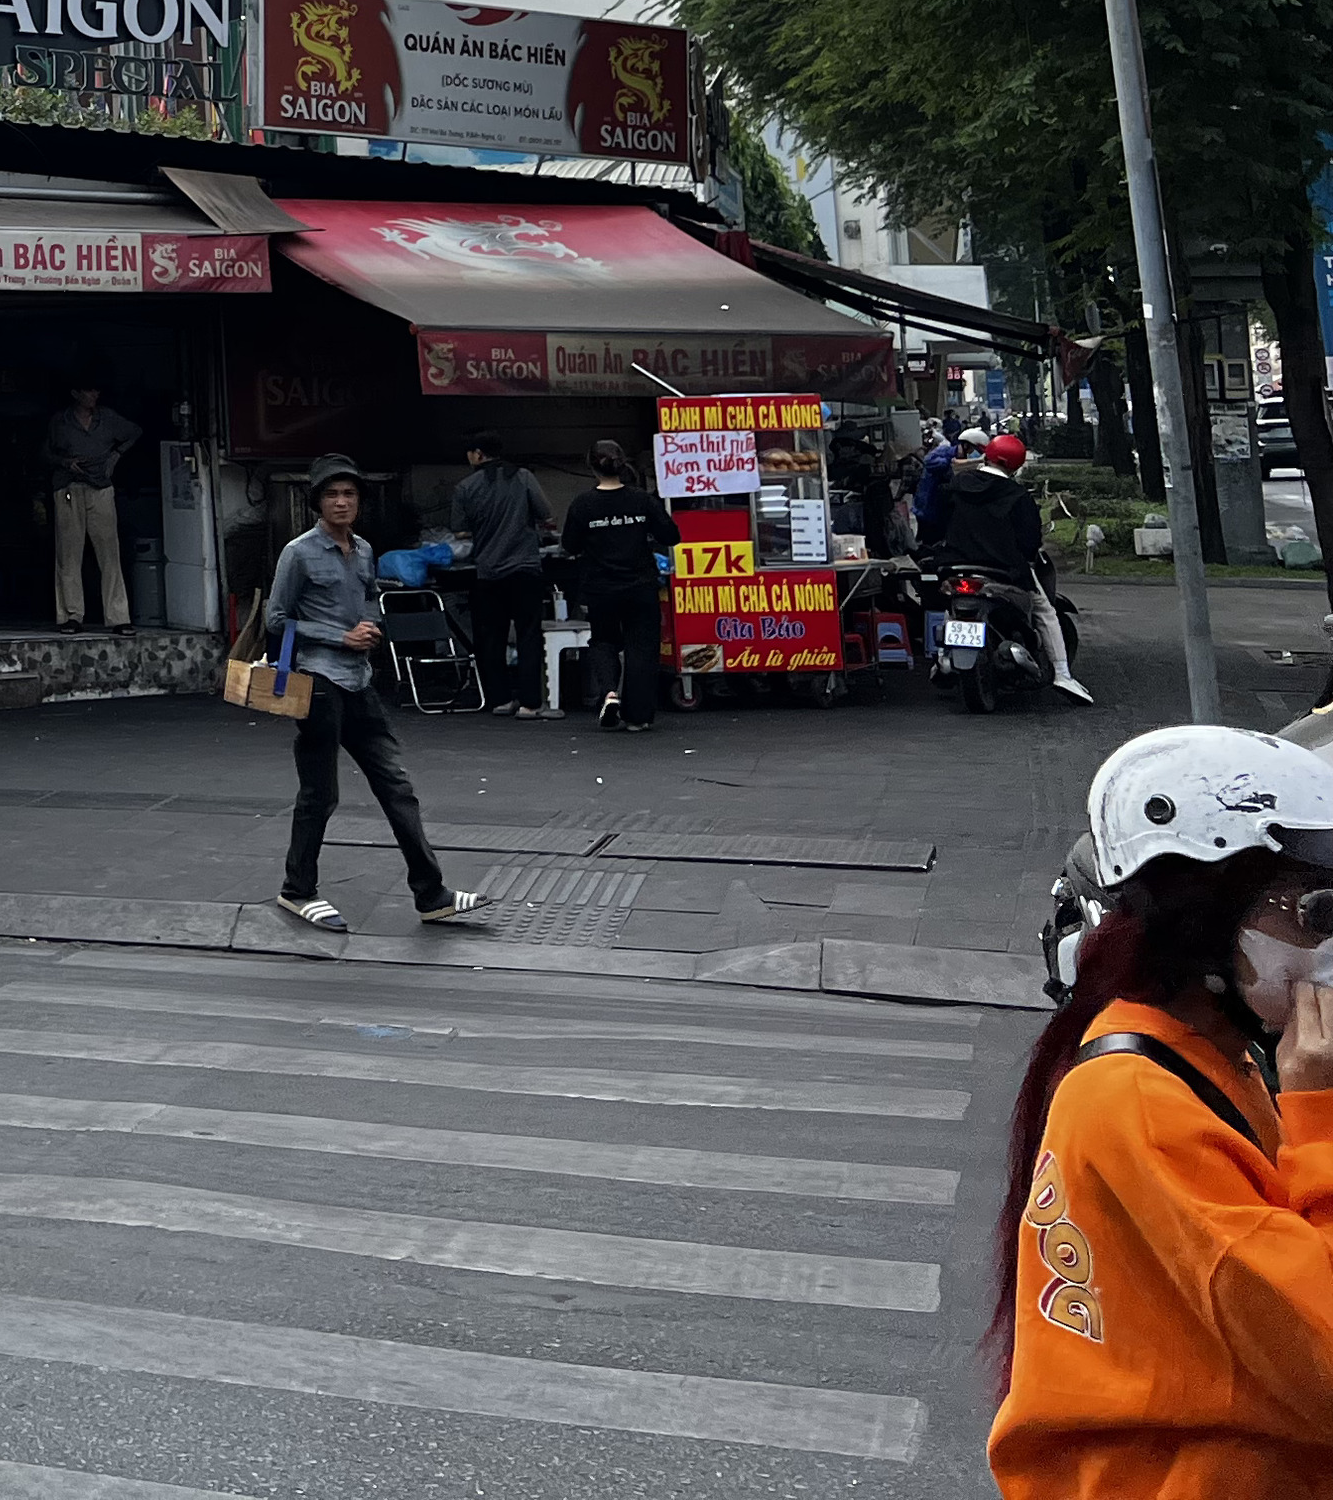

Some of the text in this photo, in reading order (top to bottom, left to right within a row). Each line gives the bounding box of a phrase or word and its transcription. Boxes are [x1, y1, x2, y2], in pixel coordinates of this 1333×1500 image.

[404, 32, 523, 62] QUÁN ĂN BÁC
[13, 44, 238, 102] SPECIAL
[310, 81, 337, 97] BIA
[280, 95, 367, 125] SAIGON
[627, 112, 650, 127] BIA
[600, 125, 676, 153] SAIGON
[14, 237, 65, 270] BÁC
[214, 249, 237, 259] BIA
[188, 260, 262, 277] SAIGON
[491, 348, 515, 360] BIA
[555, 345, 597, 375] Quán
[603, 342, 623, 374] Ăn
[633, 342, 689, 376] BÁC
[841, 352, 862, 363] BIA
[466, 361, 542, 380] SAIGON
[660, 398, 821, 430] BÁNH MÌ CHẢ CÁ NÓNG
[665, 460, 701, 480] Nem
[611, 515, 634, 525] de la
[682, 544, 747, 575] 17k
[674, 575, 834, 614] BÁNH MÌ CHẢ CÁ NÓNG
[726, 645, 759, 668] Ăn
